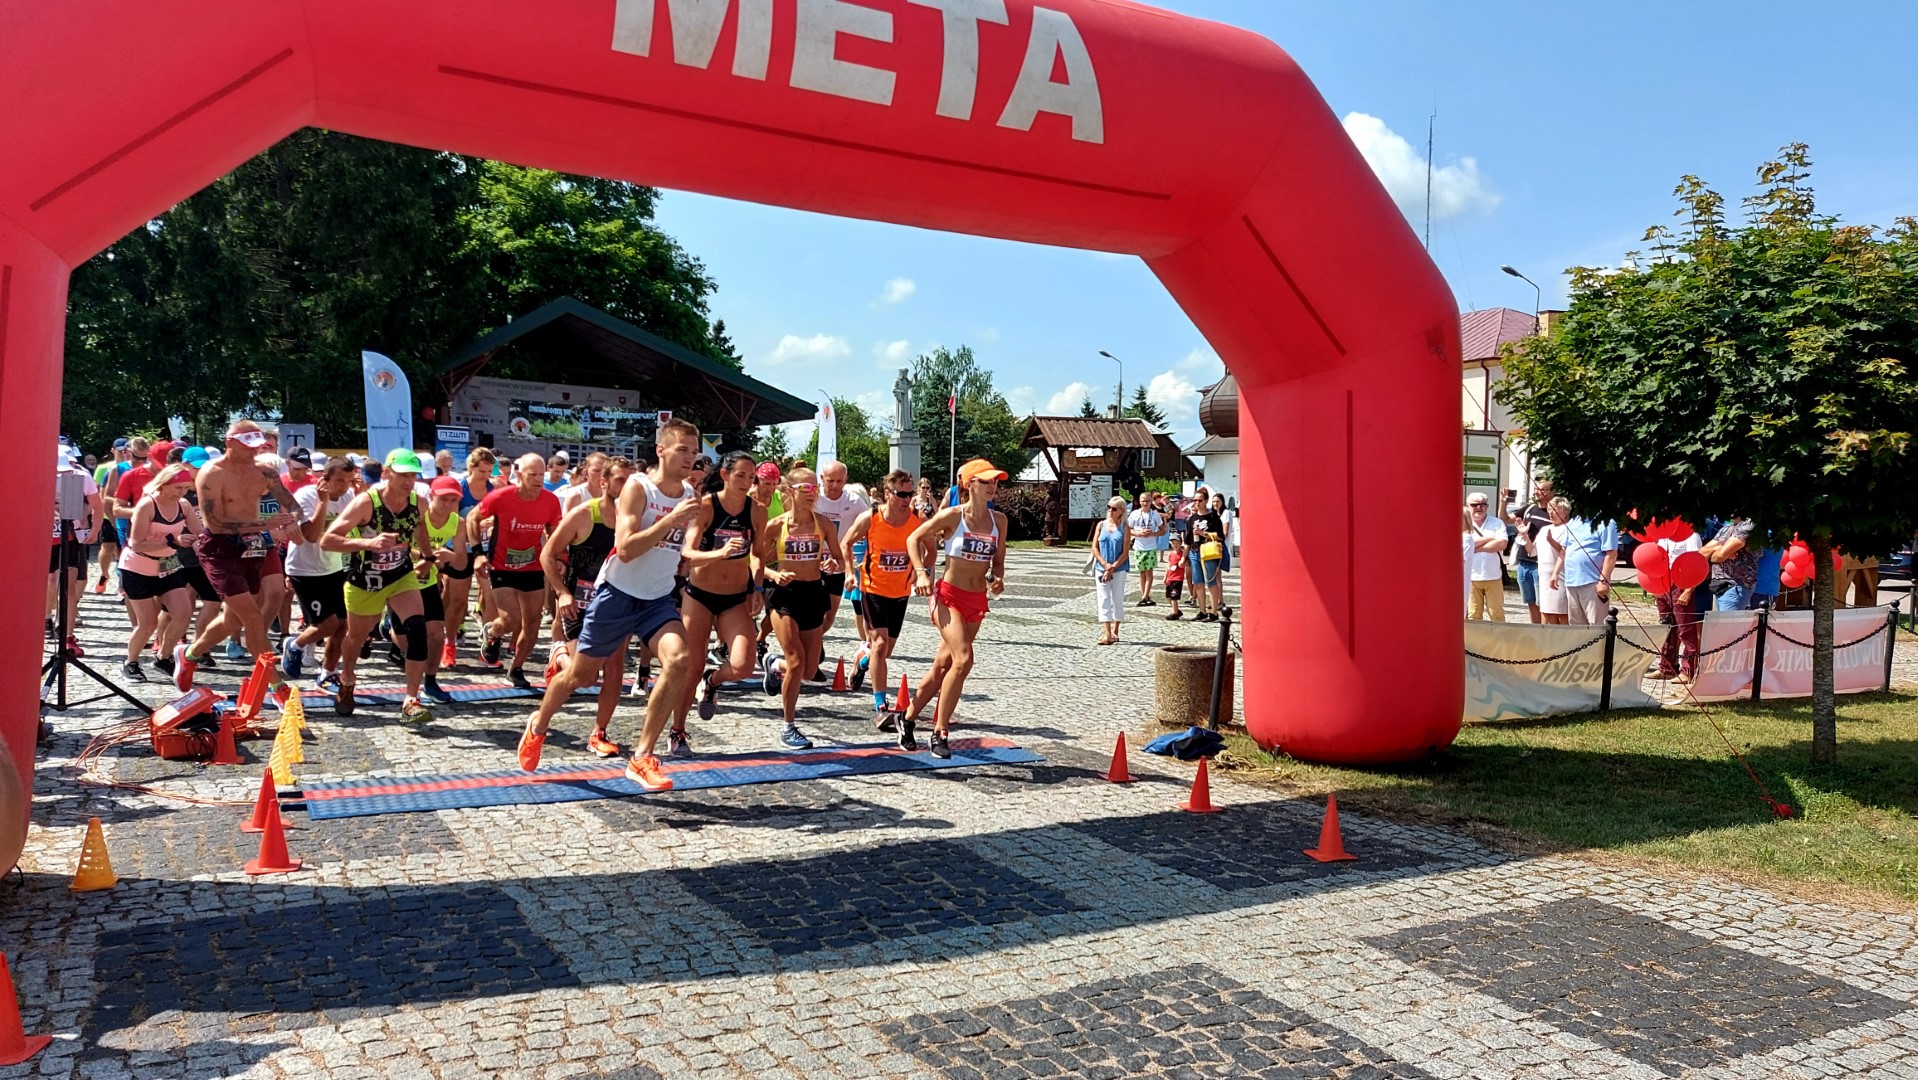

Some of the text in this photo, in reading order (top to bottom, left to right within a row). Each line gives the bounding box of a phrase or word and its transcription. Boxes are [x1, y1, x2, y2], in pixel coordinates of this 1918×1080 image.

[611, 0, 1105, 145] META
[666, 528, 682, 542] 76
[250, 539, 263, 549] 94
[791, 541, 813, 553] 181
[969, 540, 991, 554] 182
[379, 550, 401, 563] 213
[885, 555, 905, 566] 175
[583, 589, 598, 601] 19
[310, 600, 322, 617] 9
